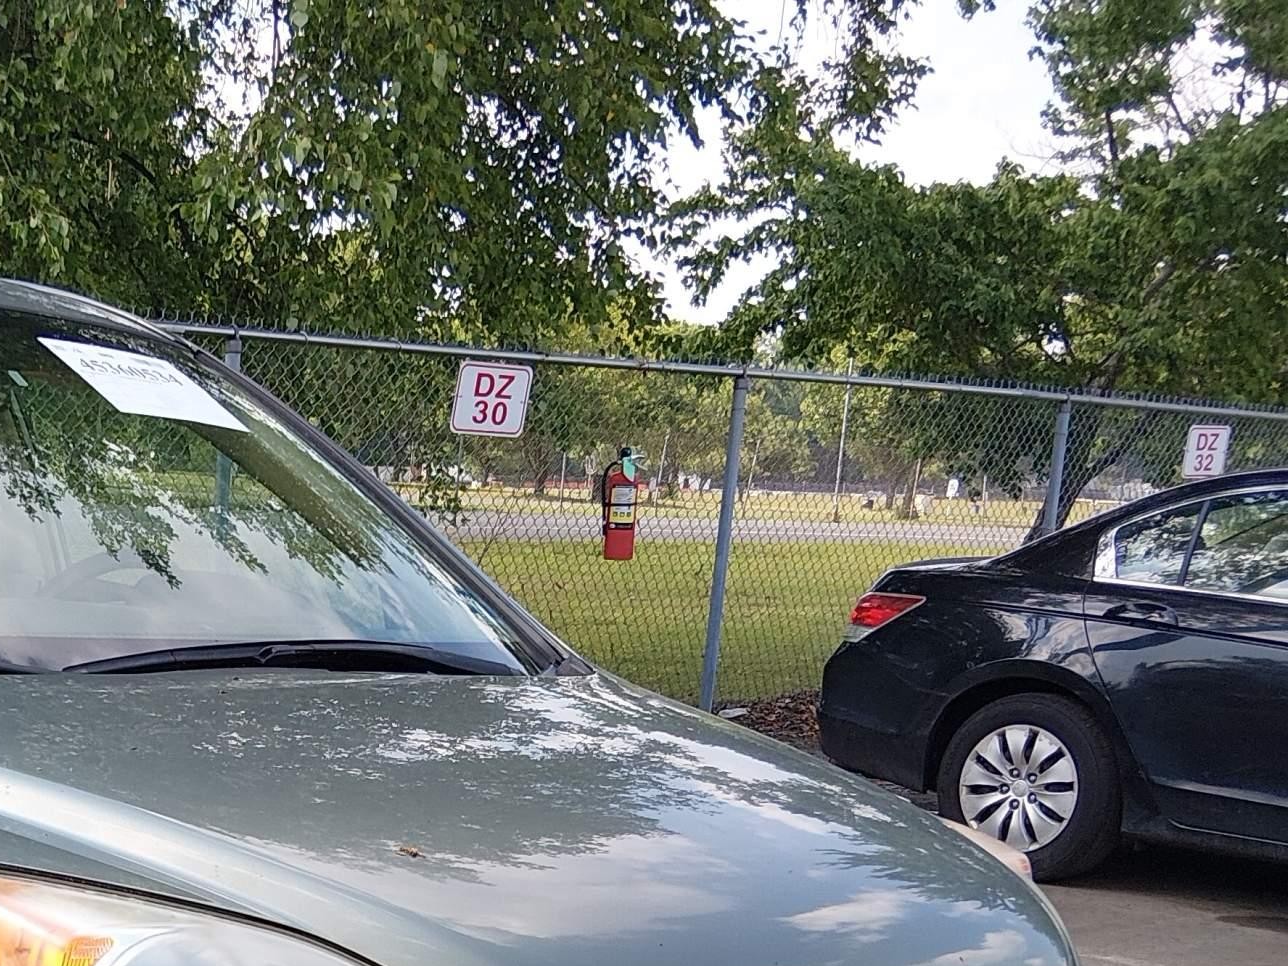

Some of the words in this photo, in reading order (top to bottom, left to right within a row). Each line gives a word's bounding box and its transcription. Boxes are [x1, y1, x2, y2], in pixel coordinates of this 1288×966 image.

[473, 371, 516, 400] DZ
[471, 399, 508, 426] 30
[1195, 432, 1220, 451] DZ
[1193, 453, 1214, 472] 32
